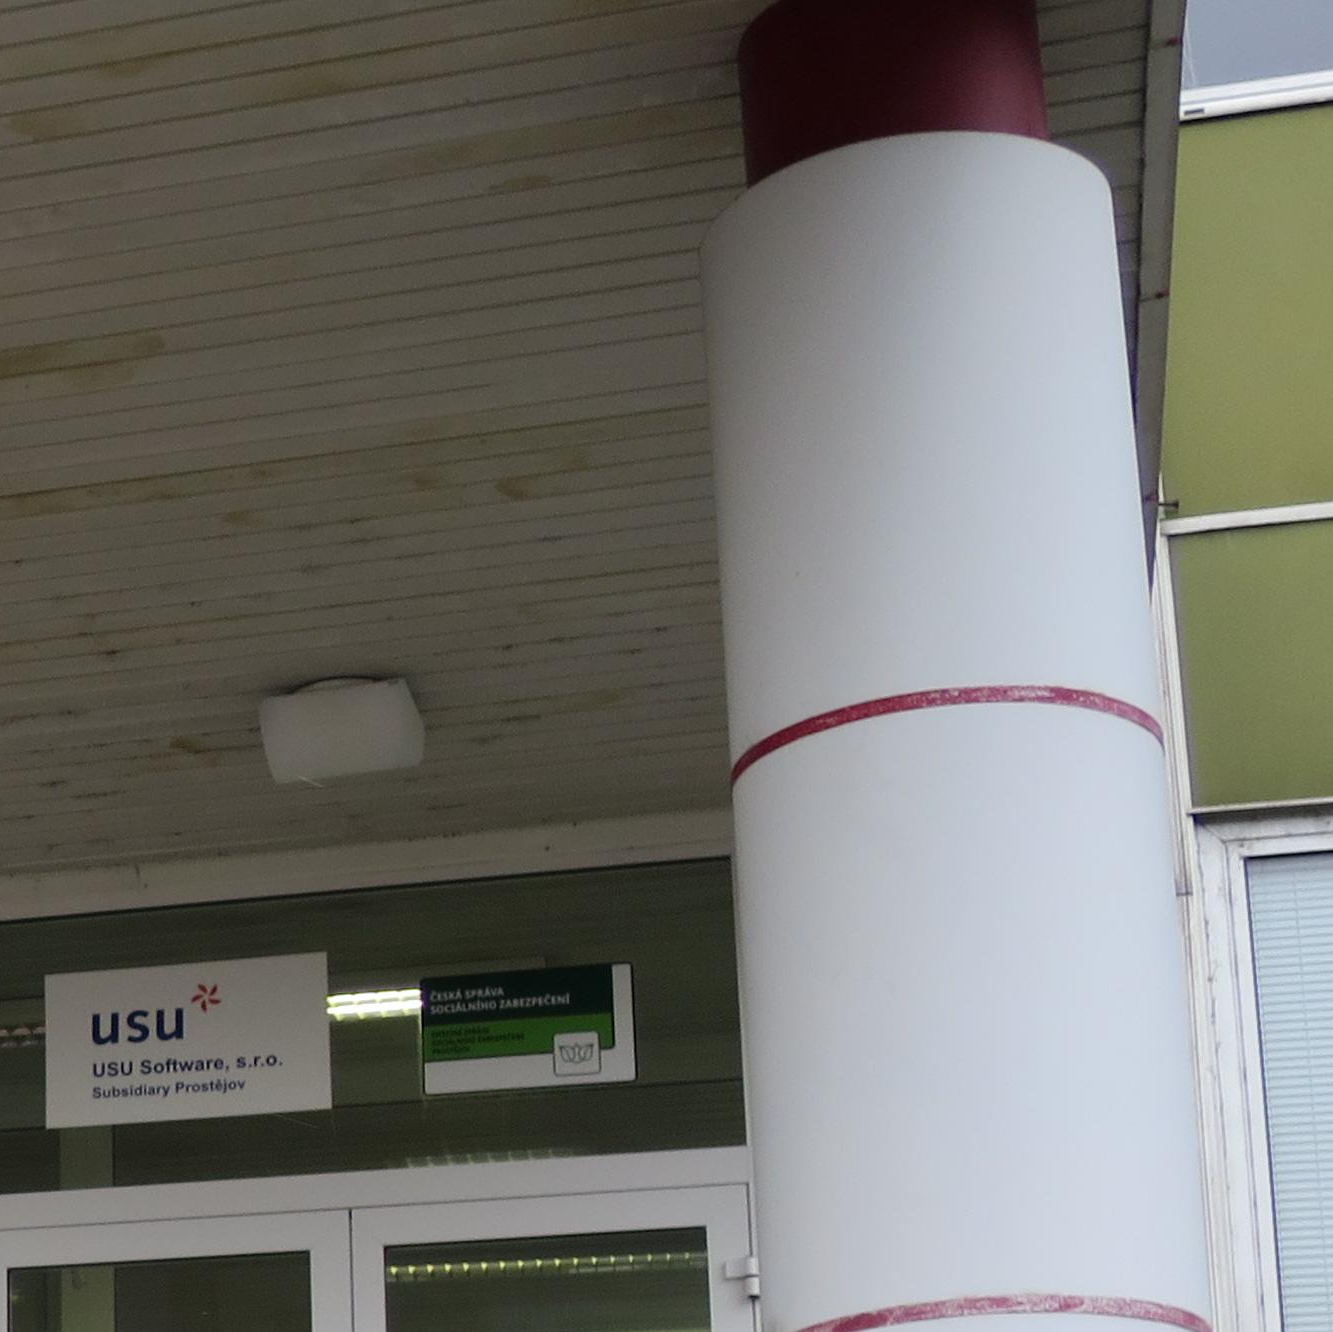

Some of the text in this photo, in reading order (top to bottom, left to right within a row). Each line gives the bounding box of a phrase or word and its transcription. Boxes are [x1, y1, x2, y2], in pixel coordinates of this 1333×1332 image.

[430, 985, 506, 1002] ČESKÁ SPRÁVA
[430, 994, 571, 1015] SOCIÁLNÍHO ZABEZPEČENÍ
[91, 1007, 184, 1046] usu
[93, 1053, 284, 1078] USU Software, s.r.o.
[92, 1078, 246, 1099] Subsidiary Prostějov
